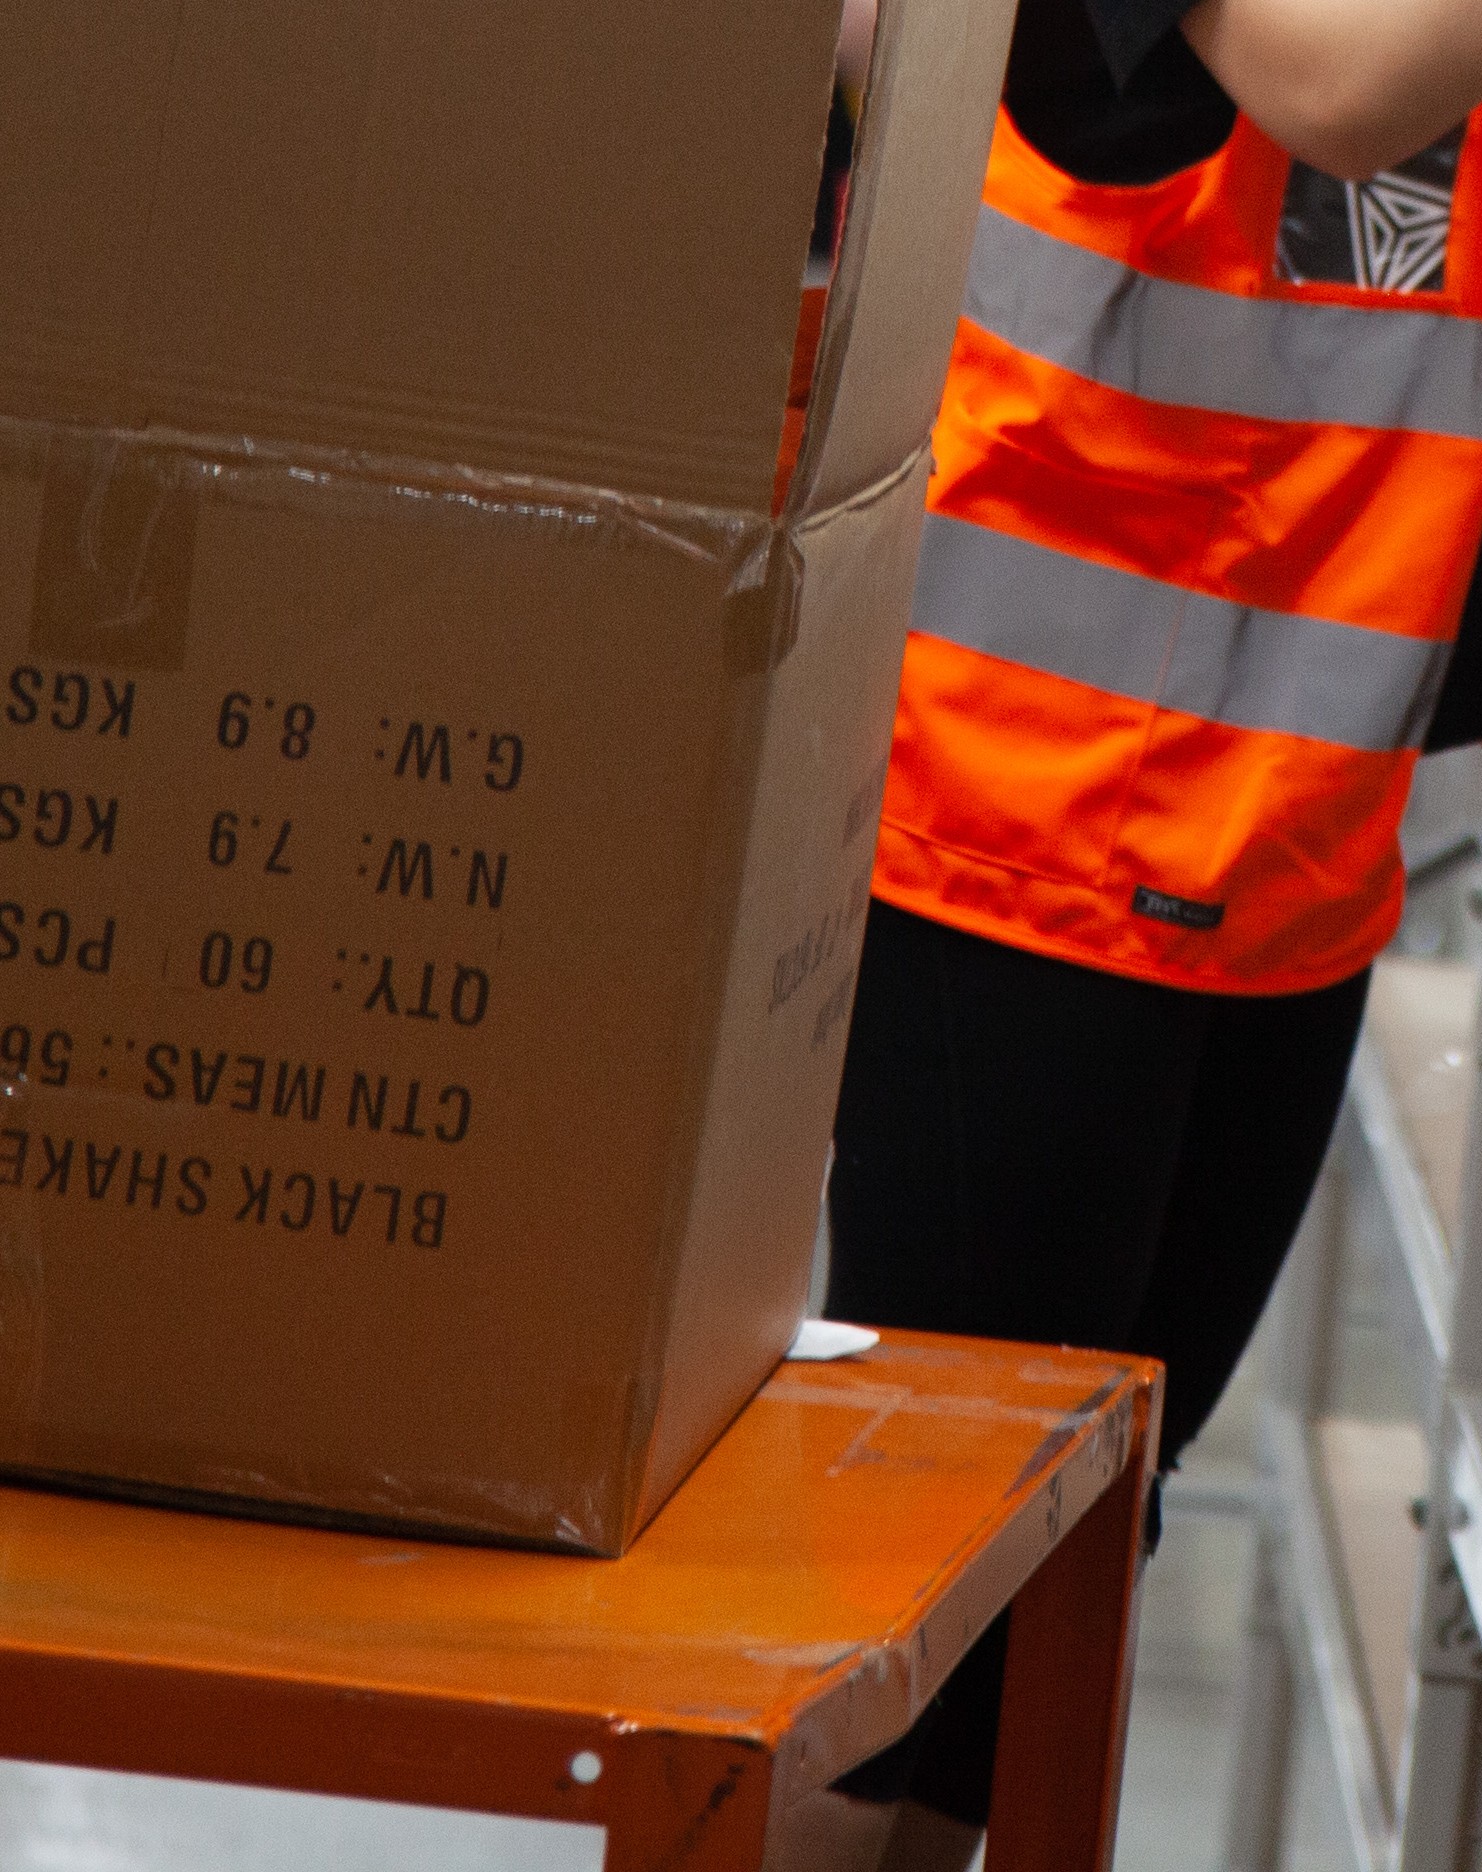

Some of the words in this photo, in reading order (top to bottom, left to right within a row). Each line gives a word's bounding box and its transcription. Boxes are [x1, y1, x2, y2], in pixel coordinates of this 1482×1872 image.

[6, 665, 136, 738] KGS
[216, 689, 317, 761] 8.9
[373, 715, 526, 794] G.W:
[0, 783, 119, 856] KGS
[207, 809, 294, 876] 7.9
[357, 832, 509, 910] N.W:
[0, 901, 116, 975] PCS
[200, 930, 274, 995] 60
[333, 946, 490, 1028] QTY.:
[99, 1034, 327, 1122] MEAS.:
[347, 1070, 473, 1145] CTN
[234, 1161, 448, 1250] BLACK
